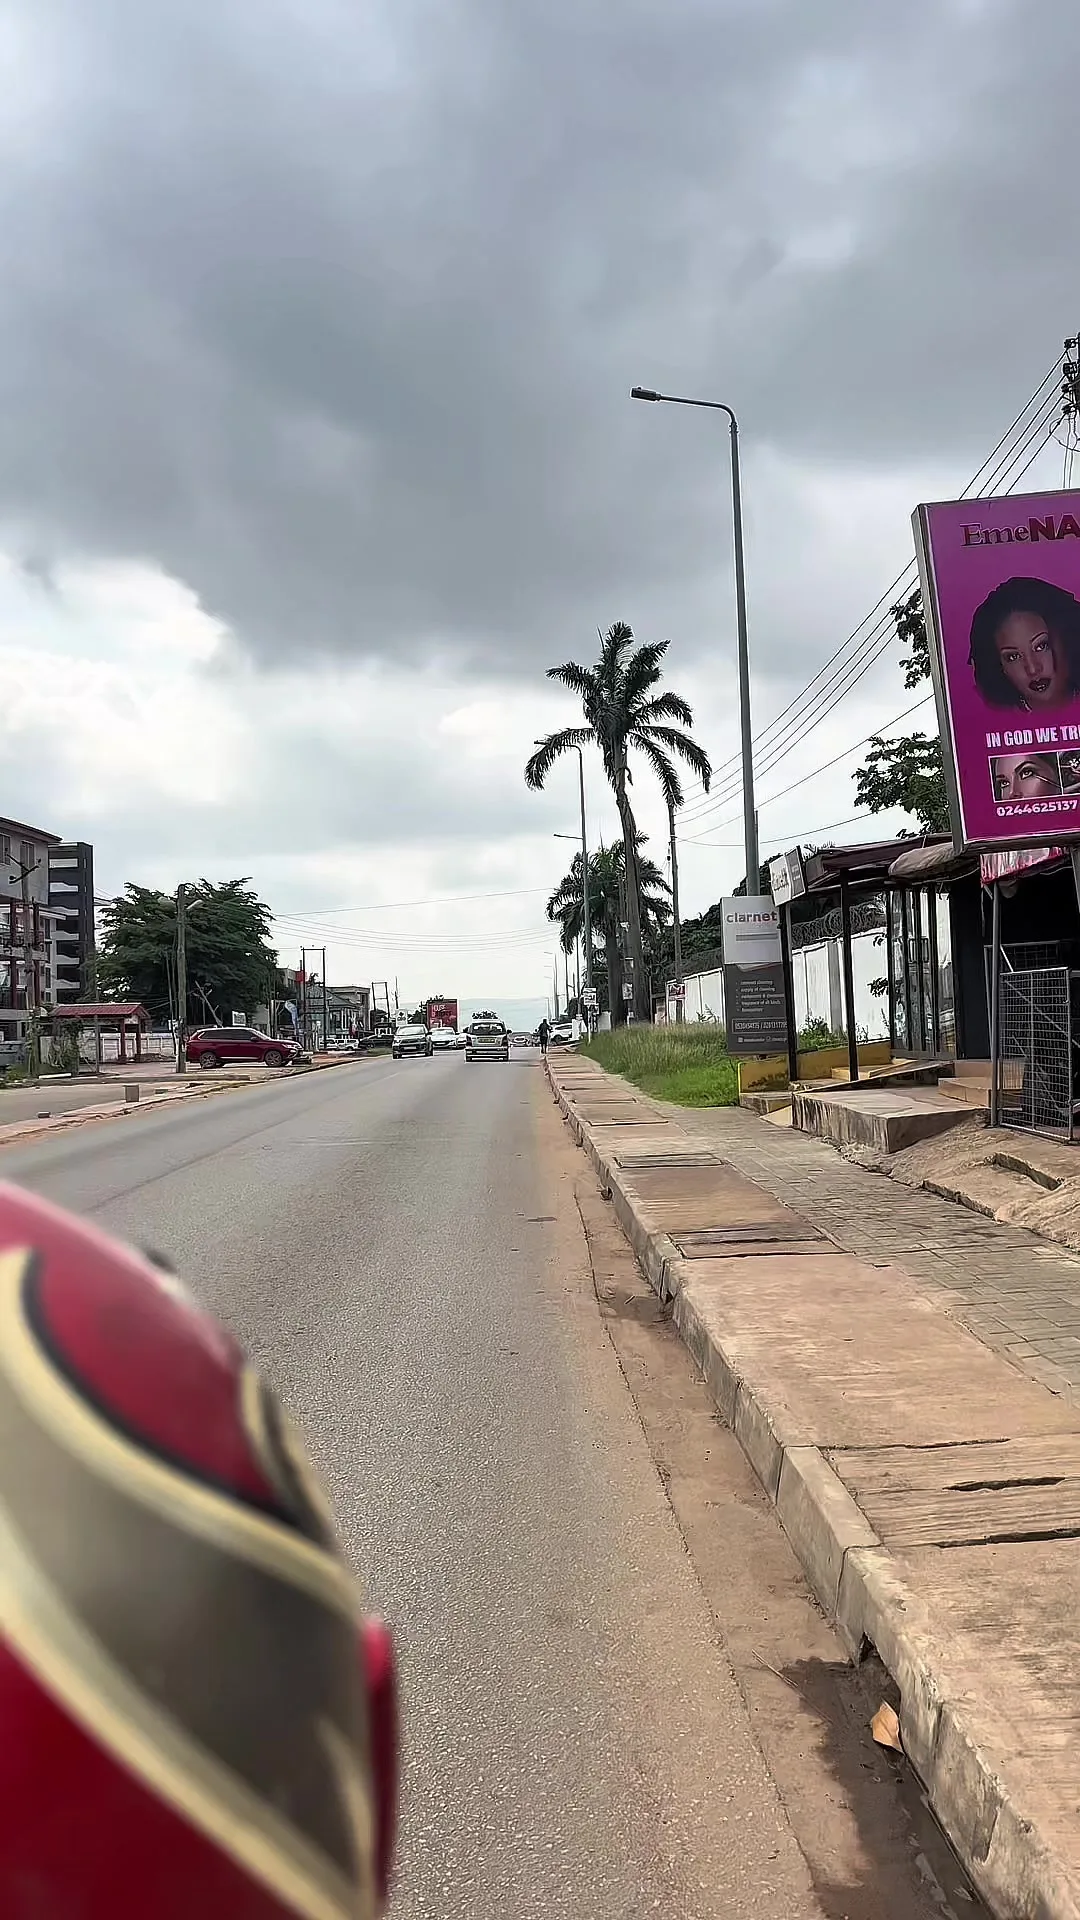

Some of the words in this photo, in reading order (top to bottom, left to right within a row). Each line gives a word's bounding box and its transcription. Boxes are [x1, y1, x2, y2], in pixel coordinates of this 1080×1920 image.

[985, 732, 1001, 748] IN
[1003, 729, 1033, 747] GOD
[1035, 727, 1058, 744] WE
[996, 800, 1078, 817] 0244625137
[726, 911, 778, 923] clarnet
